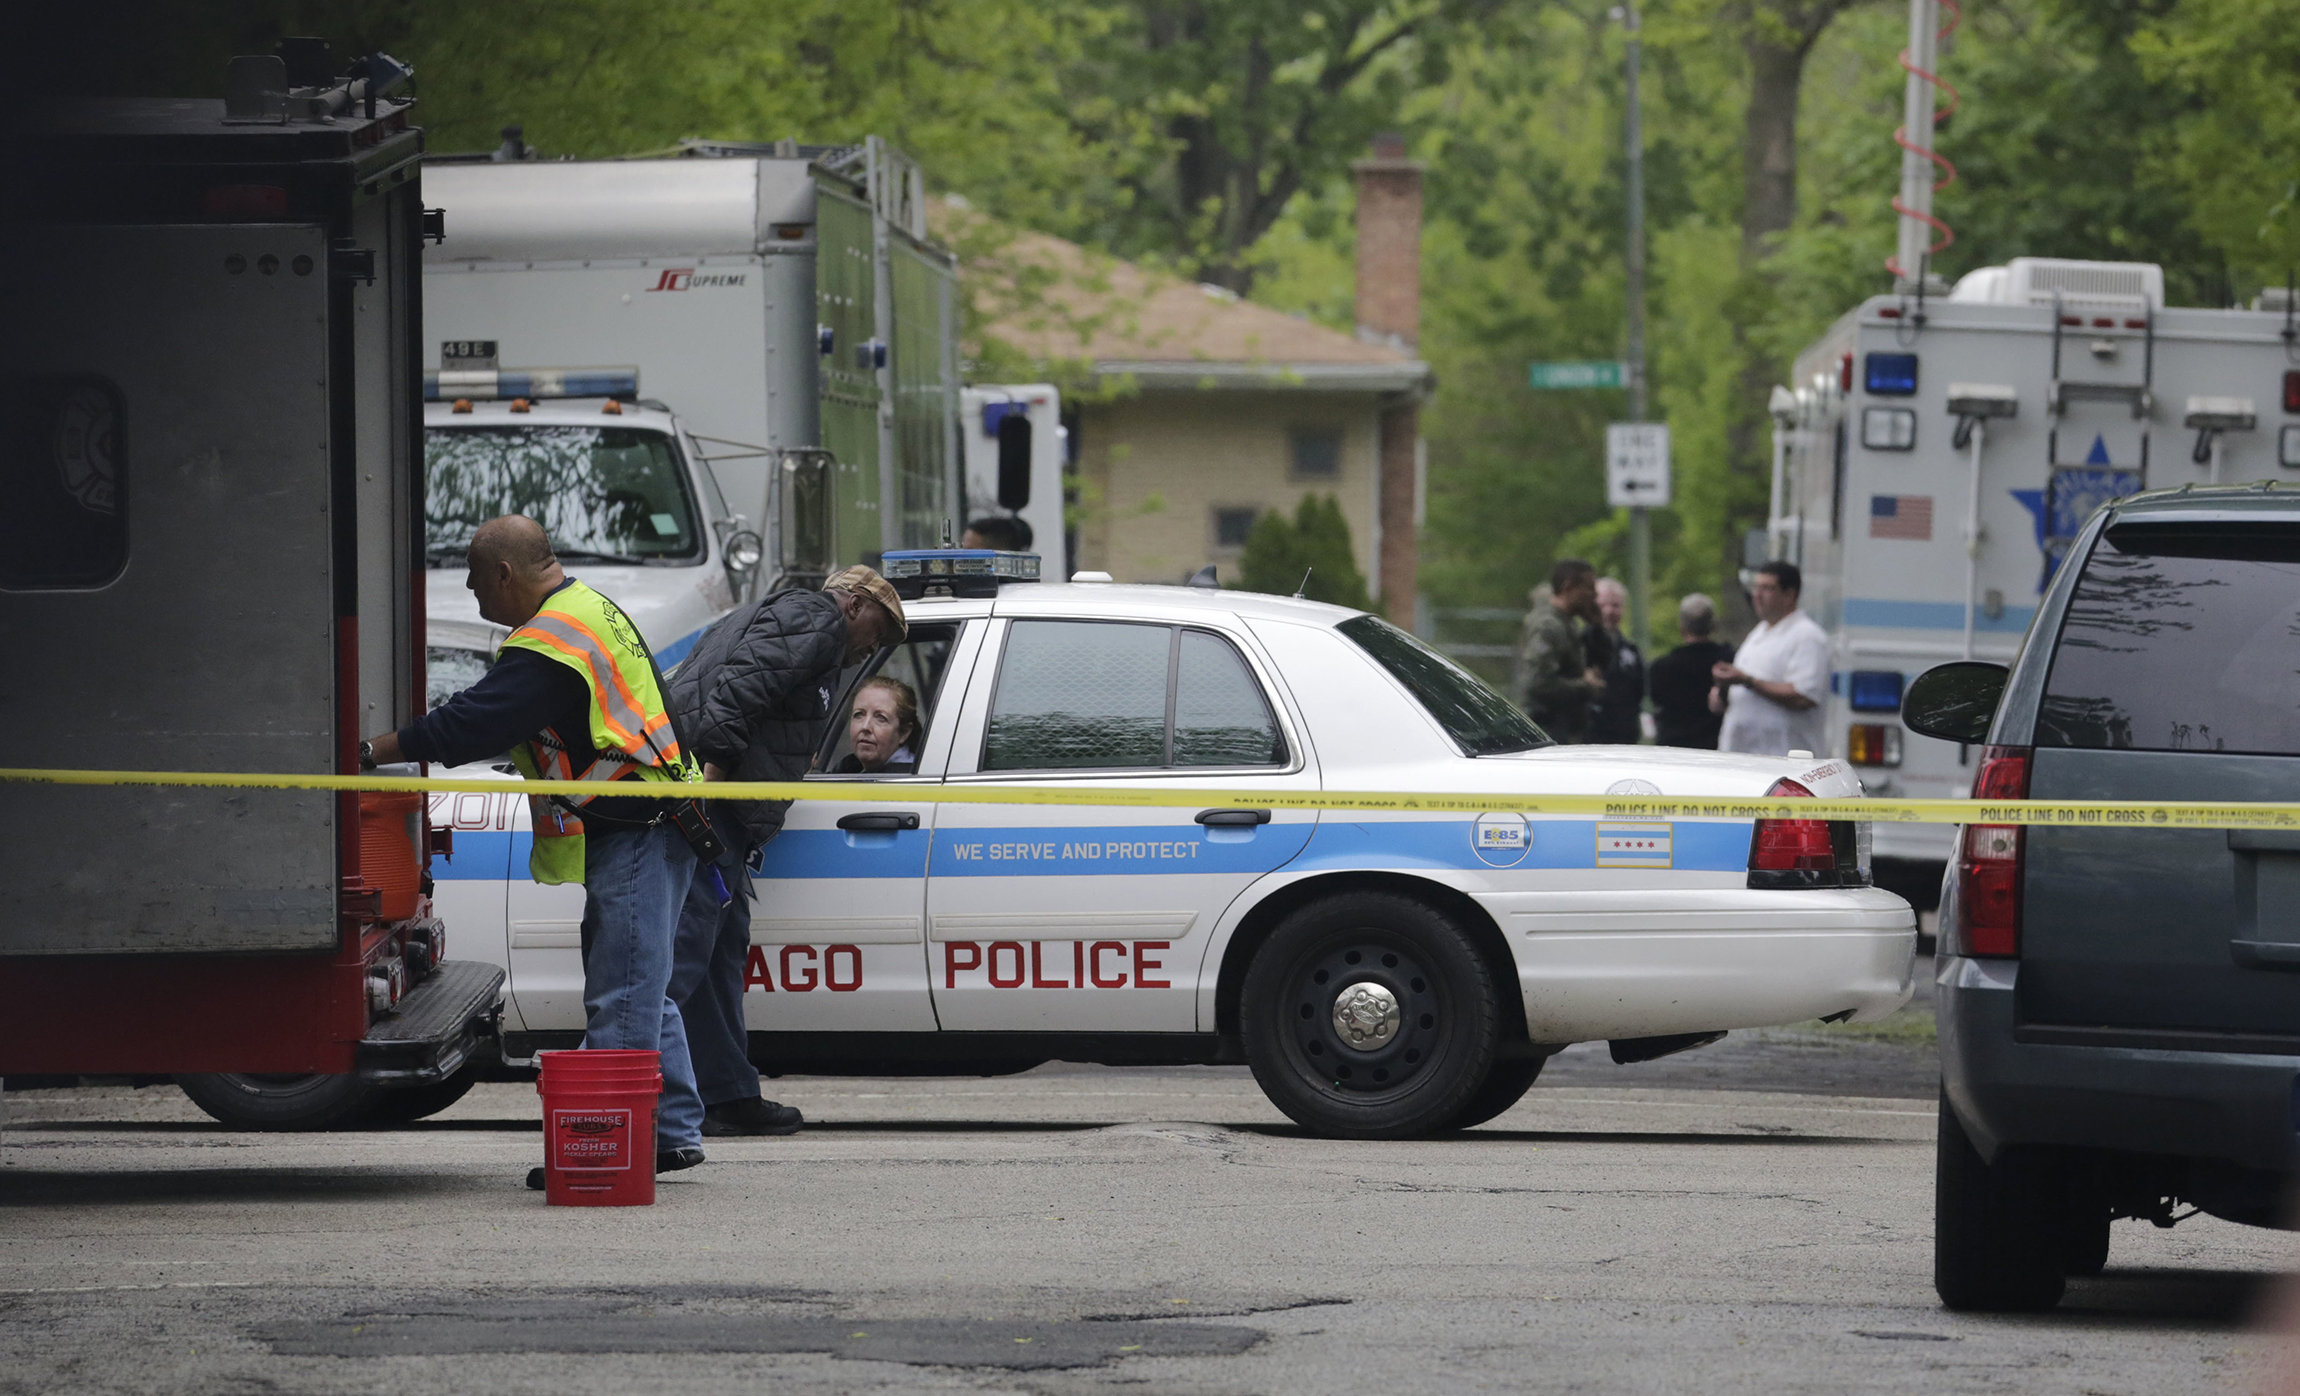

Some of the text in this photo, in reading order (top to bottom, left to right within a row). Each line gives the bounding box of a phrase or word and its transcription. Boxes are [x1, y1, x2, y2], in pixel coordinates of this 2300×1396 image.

[685, 273, 746, 288] SUPREME
[1605, 804, 1770, 818] POLICE LINE DO NOT CROSS
[1980, 807, 2145, 823] POLICE LINE DO NOT CROSS
[953, 841, 1201, 861] WE SERVE AND PROTECT
[945, 940, 1171, 989] POLICE
[560, 1115, 622, 1127] FIREHOUSE
[563, 1143, 617, 1151] KOSHER
